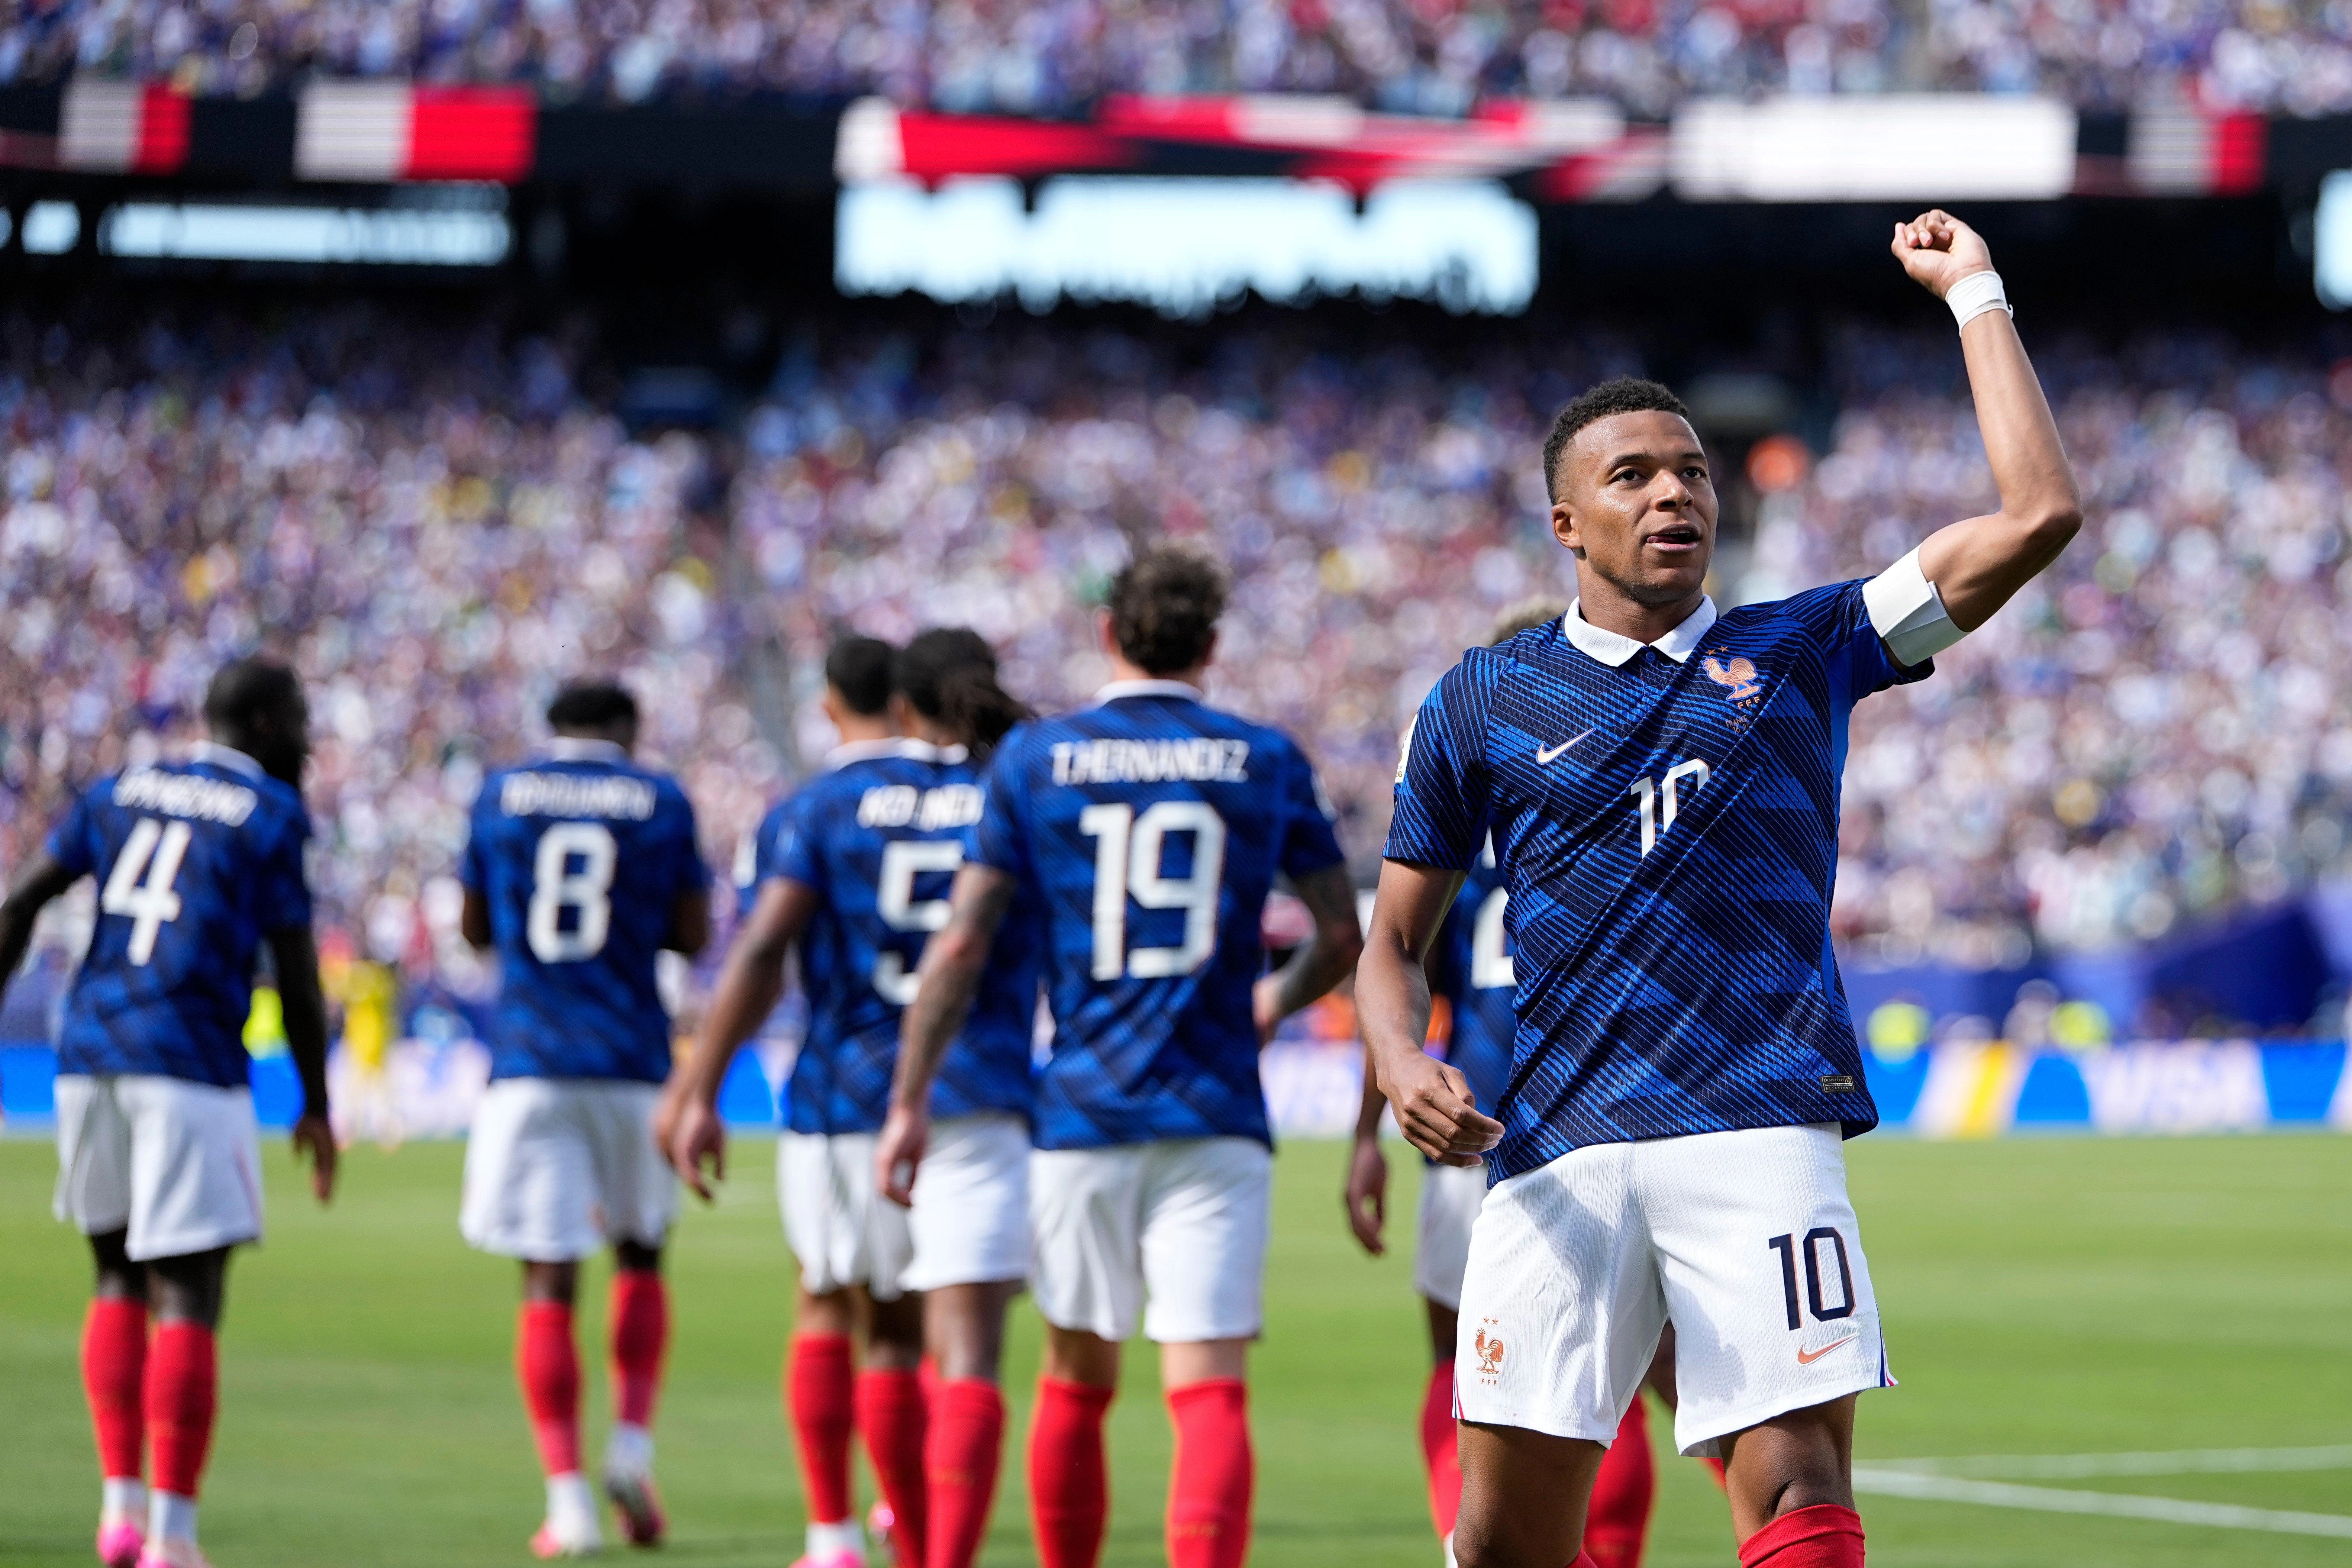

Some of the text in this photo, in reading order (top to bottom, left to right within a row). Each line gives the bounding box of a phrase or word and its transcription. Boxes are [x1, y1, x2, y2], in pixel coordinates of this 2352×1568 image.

[1726, 715, 1747, 728] FRANCE
[1733, 725, 1740, 733] 16
[1737, 696, 1759, 710] FFF
[101, 817, 192, 966] 4
[526, 821, 618, 964] 8
[871, 840, 965, 1006] 5
[1079, 801, 1227, 982] 19
[1769, 1227, 1856, 1331] 10
